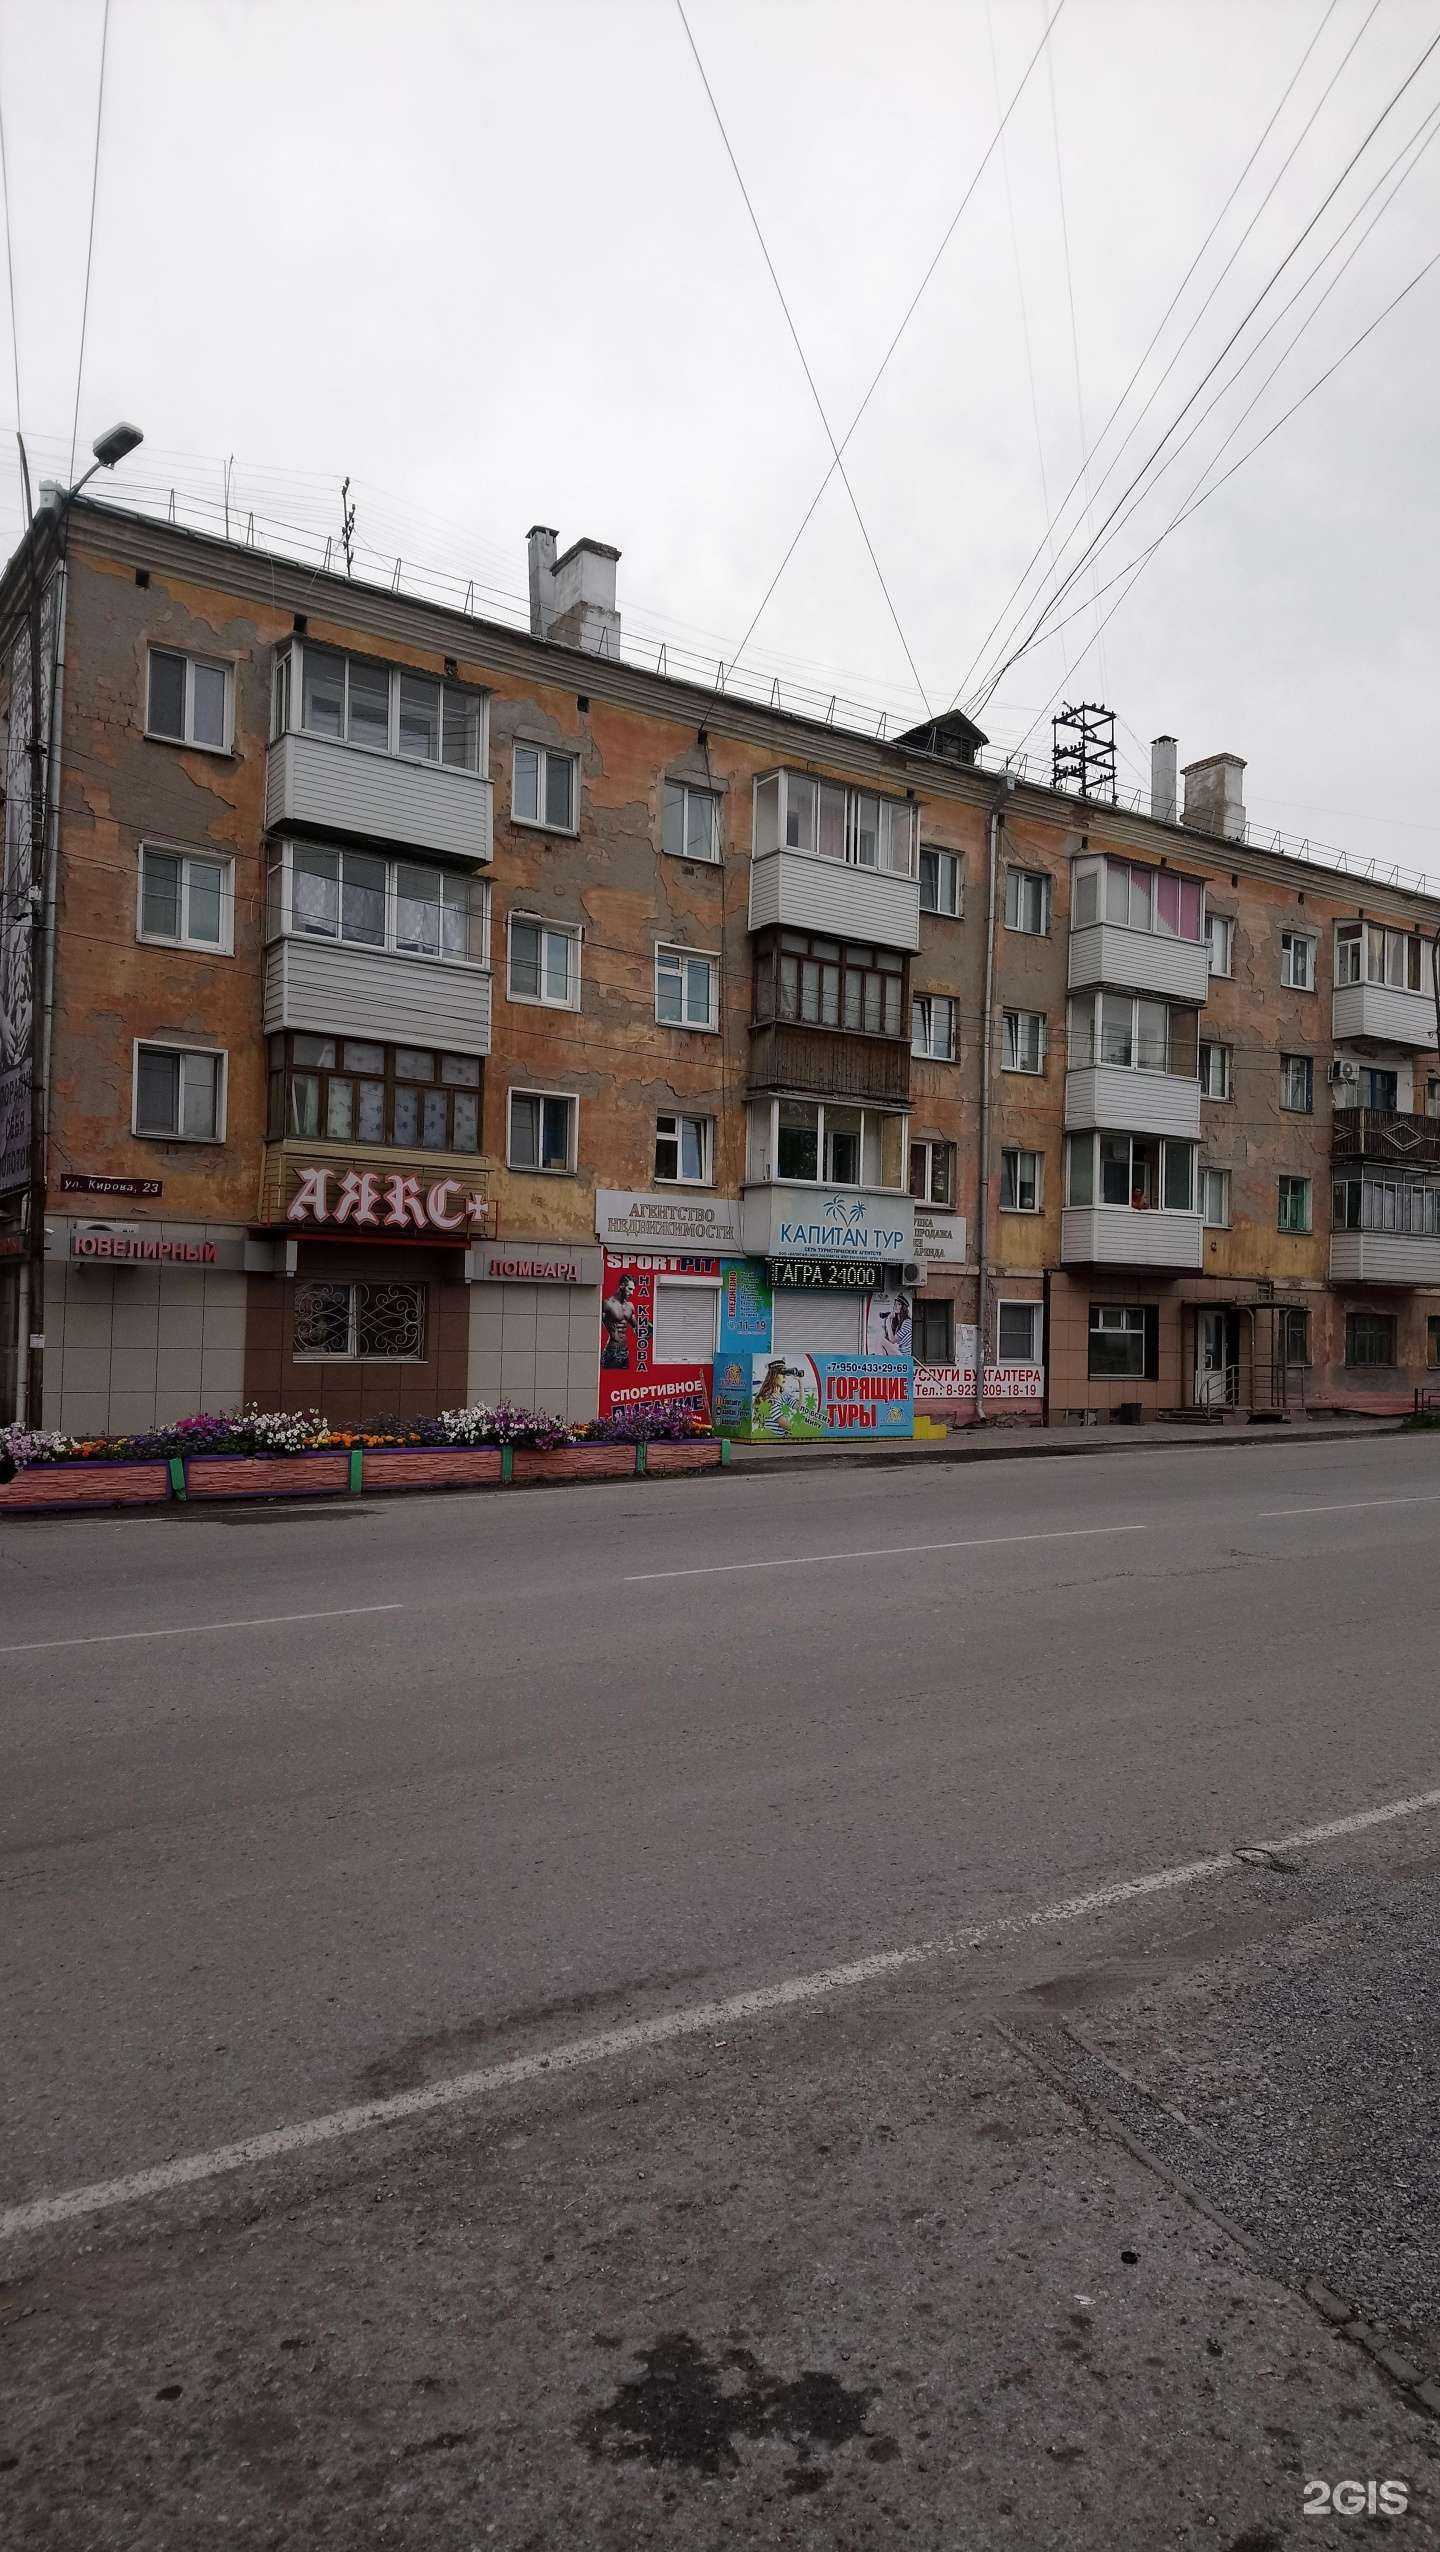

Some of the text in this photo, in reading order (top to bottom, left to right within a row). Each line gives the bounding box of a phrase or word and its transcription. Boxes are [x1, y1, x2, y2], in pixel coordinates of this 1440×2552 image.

[65, 1179, 159, 1193] ул. Кирова, 23
[629, 1203, 716, 1222] АГЕНТСТВО
[607, 1217, 735, 1239] НЕДВИЖИМОСТИ
[73, 1236, 217, 1262] ЮВЕЛИРНЫЙ
[874, 1230, 904, 1249] ТУР
[606, 1253, 715, 1272] SPORTPIT
[913, 1248, 945, 1258] АРЕНДА
[489, 1259, 577, 1281] ЛОМБАРД
[828, 1265, 875, 1285] 24000
[638, 1275, 649, 1297] НА
[728, 1270, 737, 1317] ЕЖЕДНЕВНО
[636, 1305, 650, 1372] КИРОВА
[610, 1380, 703, 1402] СПОРТИВНОЕ
[826, 1377, 908, 1403] ГОРЯЩИЕ
[800, 1405, 831, 1424] ПО ВСЕМУ
[804, 1417, 822, 1429] МИРУ
[826, 1404, 877, 1429] ТУРЫ
